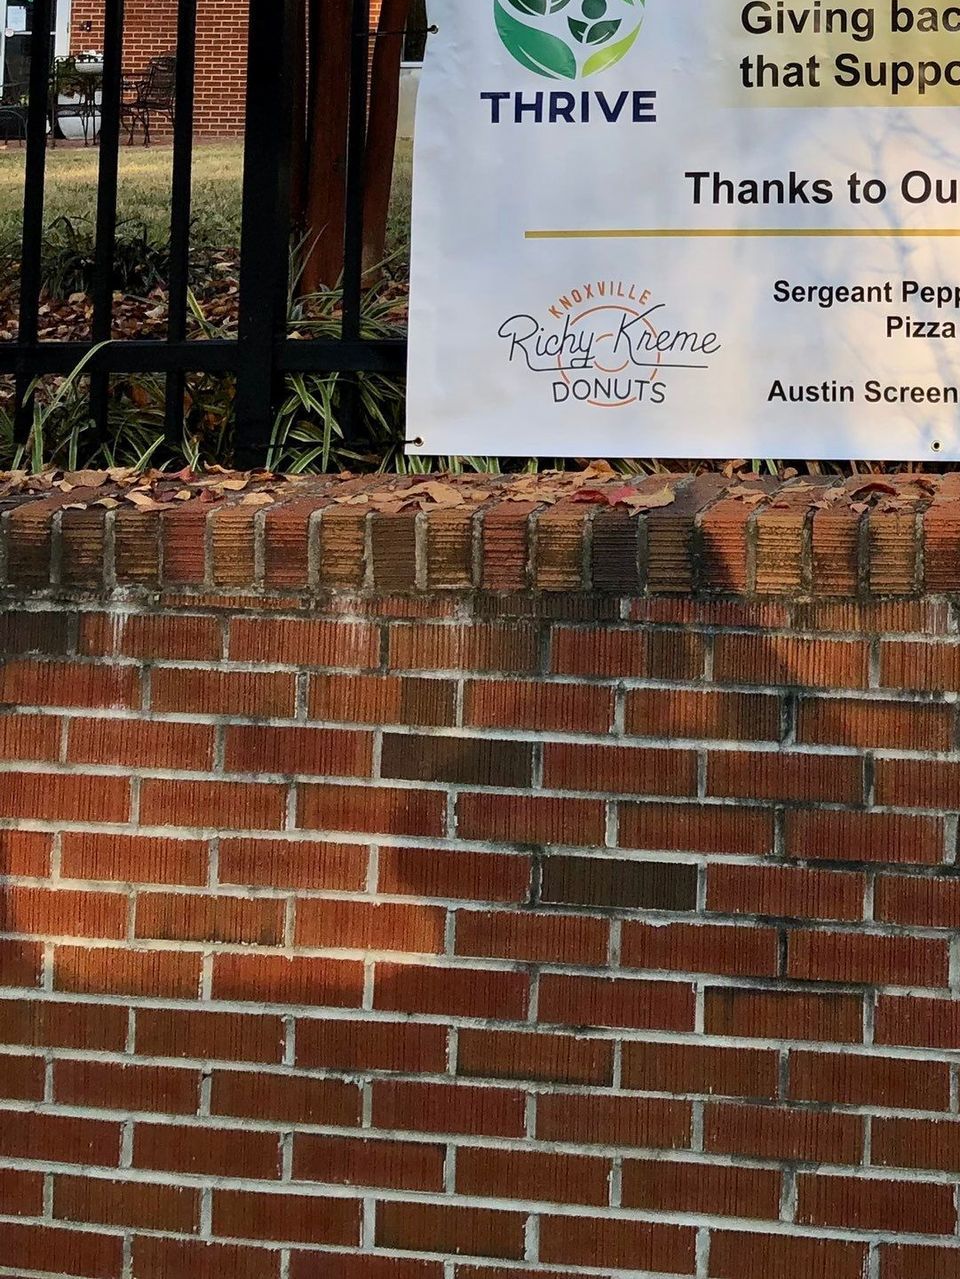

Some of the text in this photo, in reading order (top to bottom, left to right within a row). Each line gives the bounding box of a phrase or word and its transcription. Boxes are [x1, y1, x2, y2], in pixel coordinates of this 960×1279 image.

[740, 0, 875, 42] Giving
[740, 54, 820, 87] that
[480, 89, 657, 124] THRIVE
[684, 171, 834, 204] Thanks
[847, 172, 887, 204] to
[548, 280, 652, 319] KNOXVILLE
[773, 279, 893, 309] Sergeant
[498, 303, 722, 372] Richy Kreme
[886, 316, 956, 338] Pizza
[551, 377, 667, 404] DONUTS
[767, 379, 855, 403] Austin
[864, 380, 958, 404] Screen
